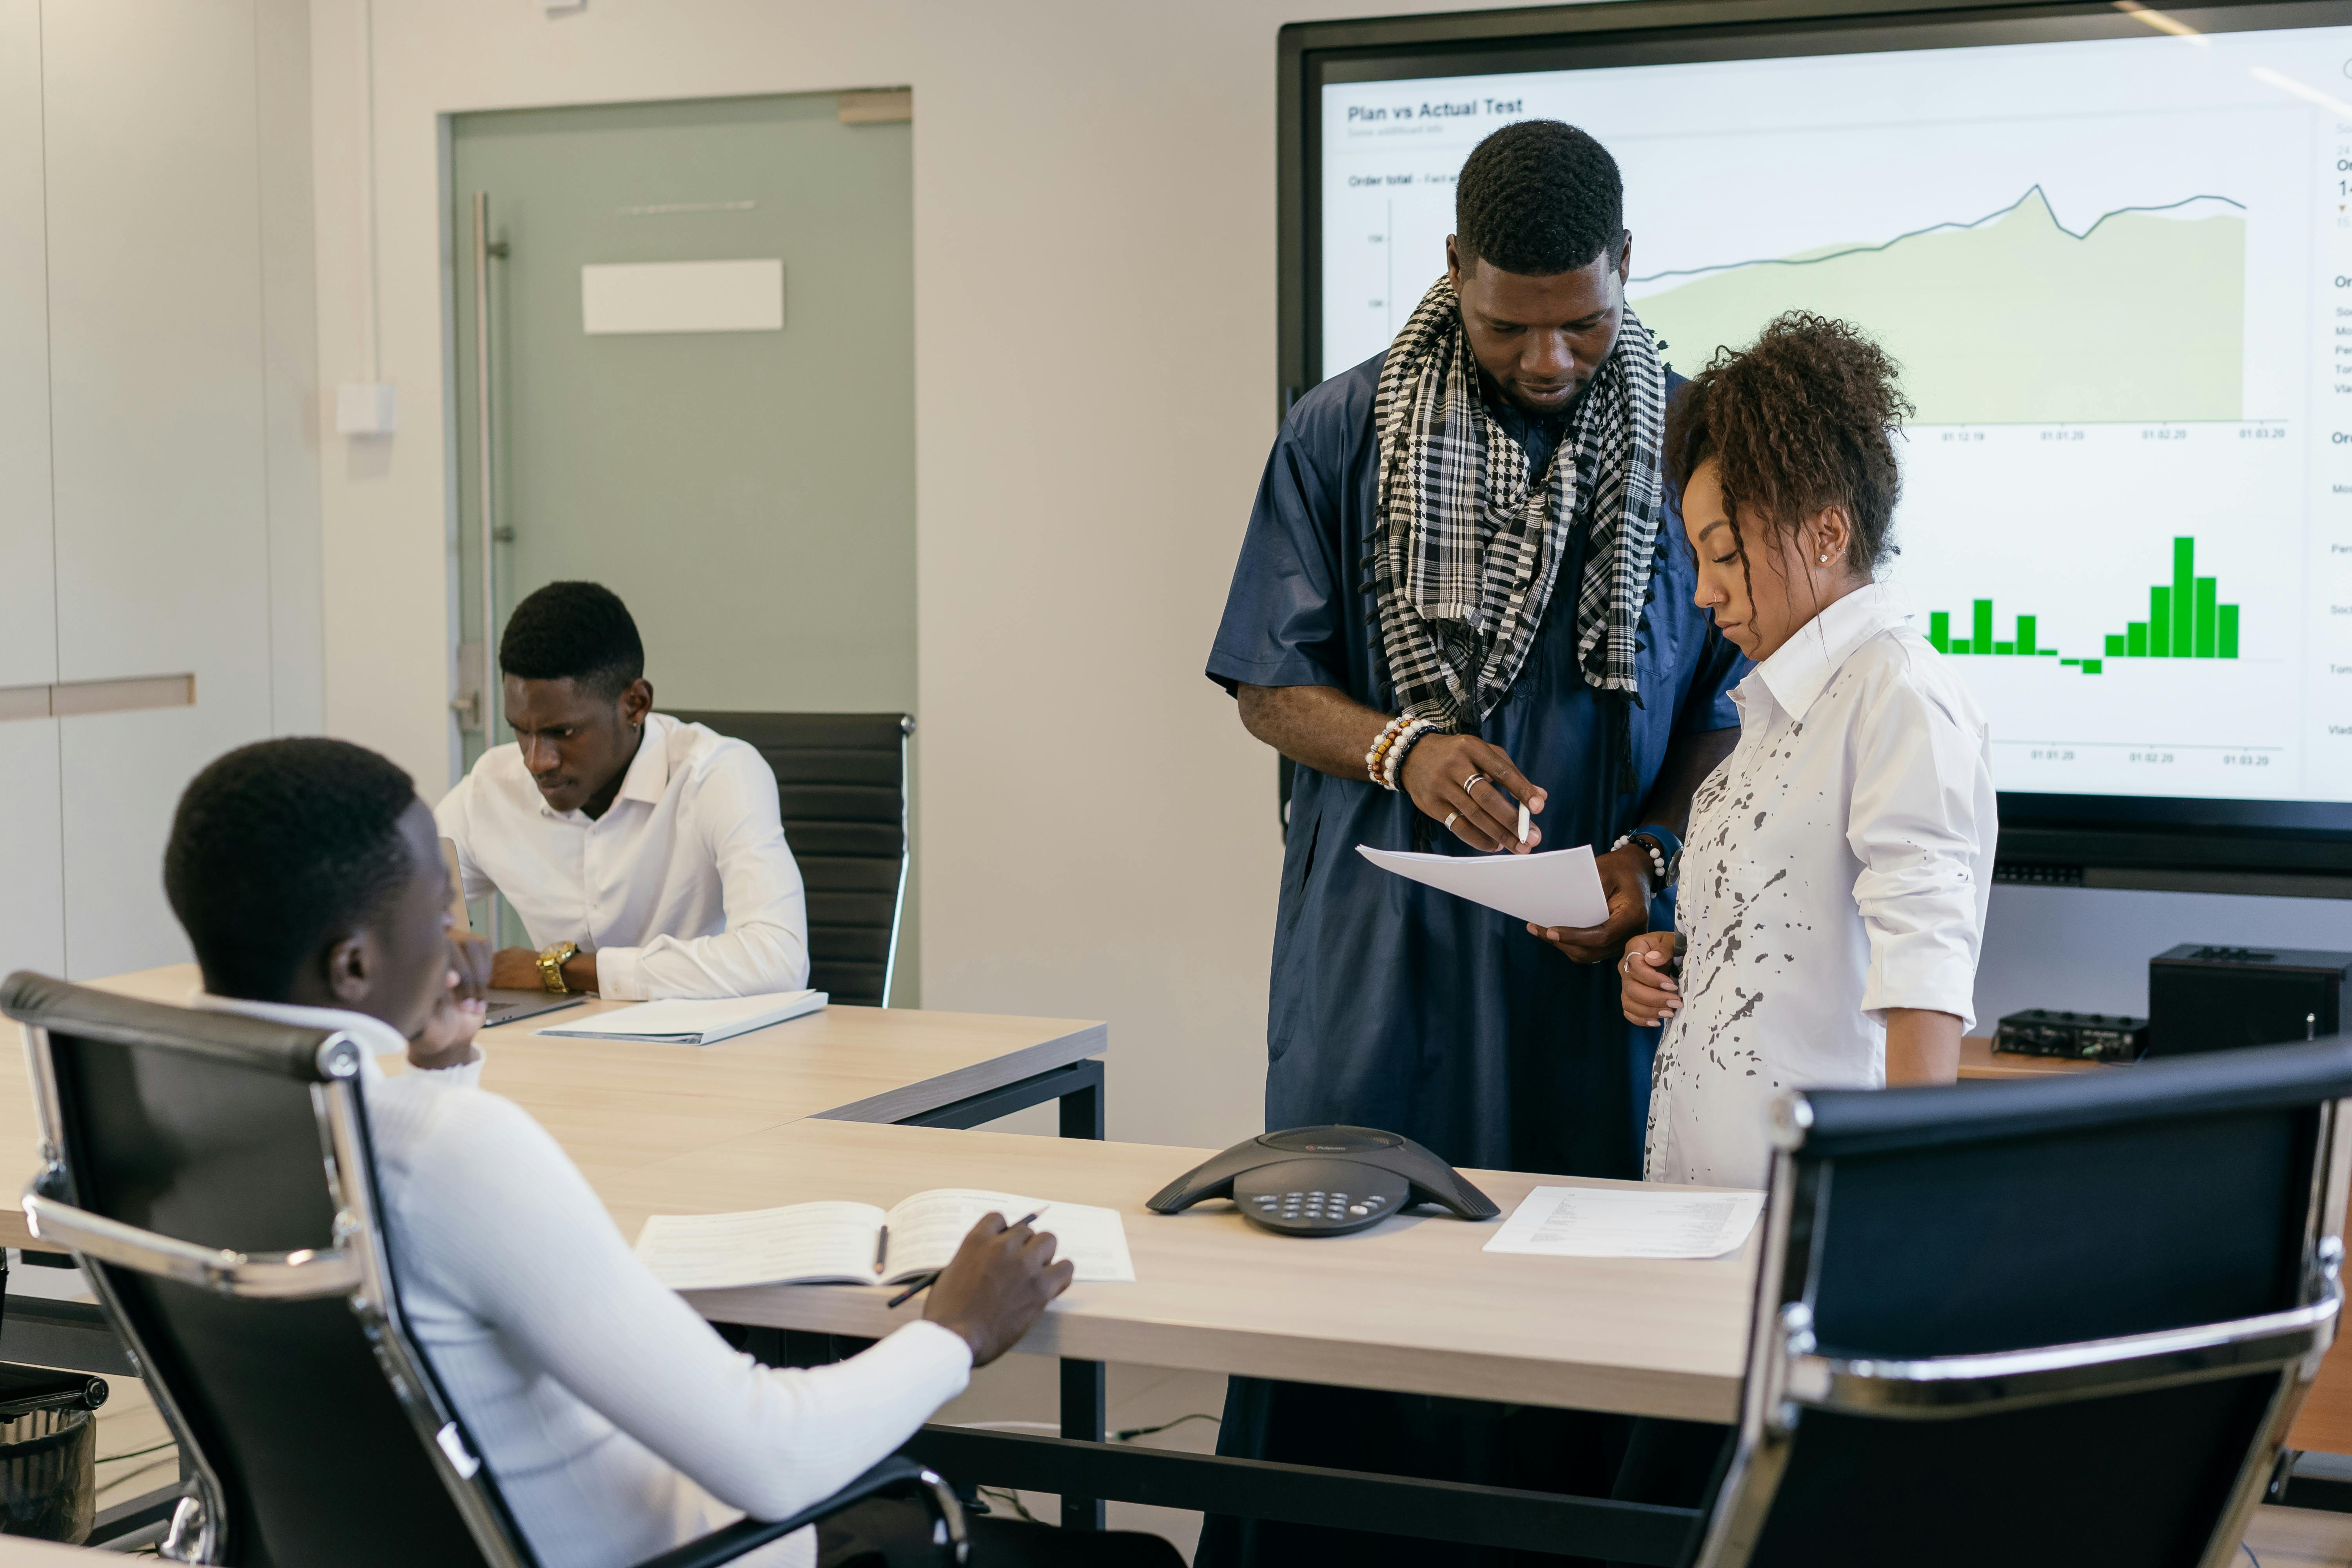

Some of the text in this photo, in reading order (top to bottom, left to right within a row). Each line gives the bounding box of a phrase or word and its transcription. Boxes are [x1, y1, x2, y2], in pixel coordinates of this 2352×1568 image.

[1348, 99, 1522, 122] Plan vs Actual Test
[1348, 175, 1383, 187] Order
[1386, 174, 1412, 185] total
